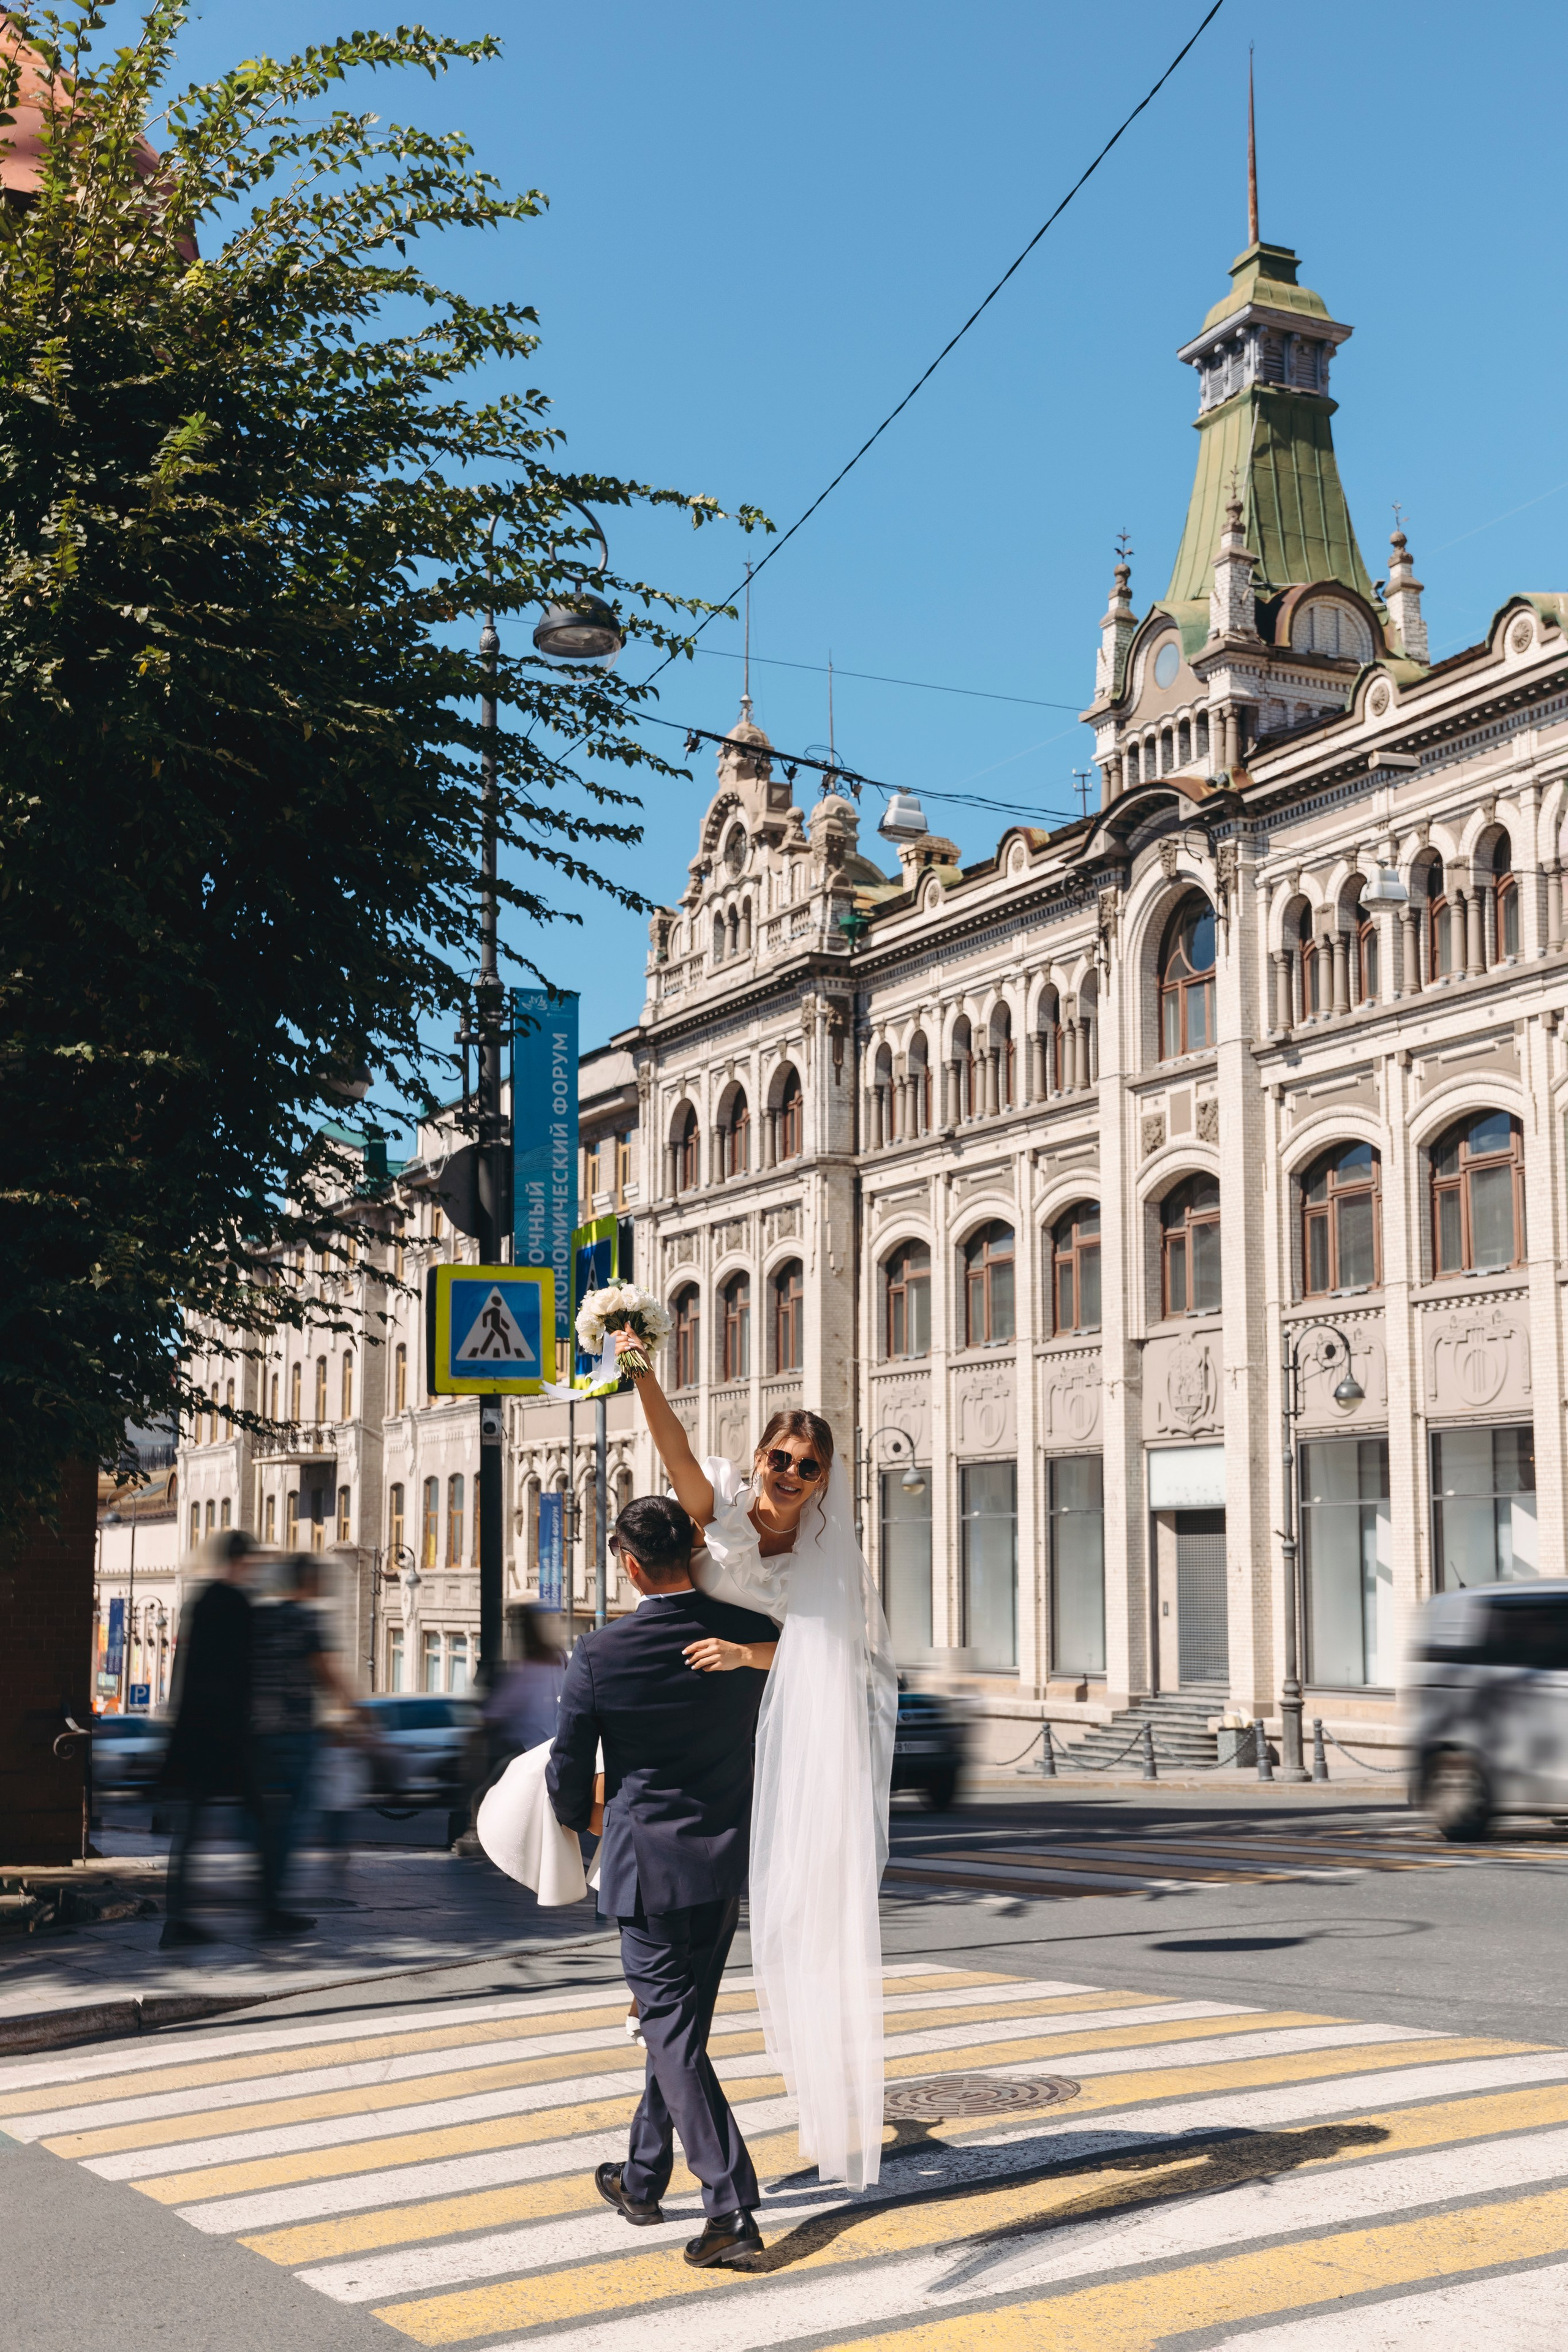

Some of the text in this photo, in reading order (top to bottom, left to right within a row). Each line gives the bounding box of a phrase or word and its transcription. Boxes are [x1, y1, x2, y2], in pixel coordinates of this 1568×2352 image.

[552, 1033, 568, 1115] ФОРУМ
[526, 1182, 545, 1267] ОЧНЫЙ
[549, 1123, 568, 1325] ЭКОНОМИЧЕСКИЙ
[134, 1685, 147, 1703] P
